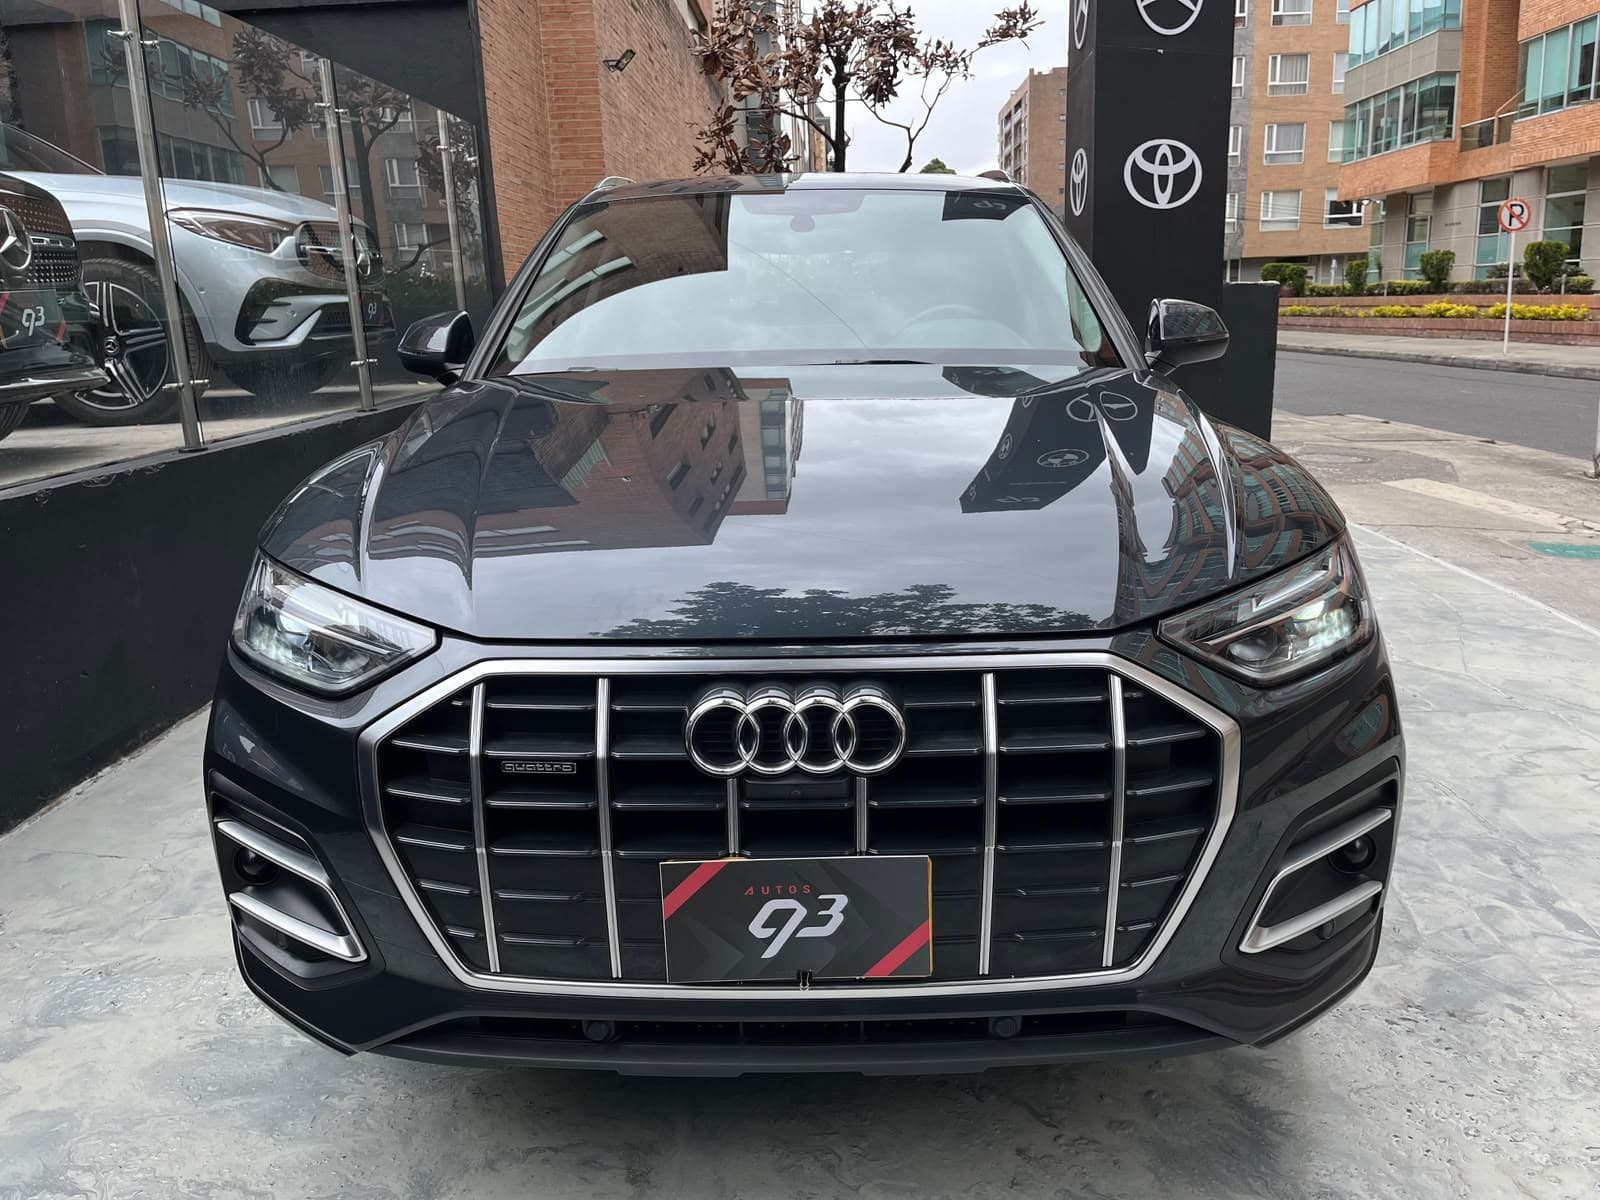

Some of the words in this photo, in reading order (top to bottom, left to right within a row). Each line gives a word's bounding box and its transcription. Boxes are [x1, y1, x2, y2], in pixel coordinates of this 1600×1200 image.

[1508, 203, 1525, 227] P
[22, 305, 46, 337] 93
[503, 762, 574, 773] quattro
[743, 884, 812, 897] AUTOS
[748, 893, 849, 959] 93
